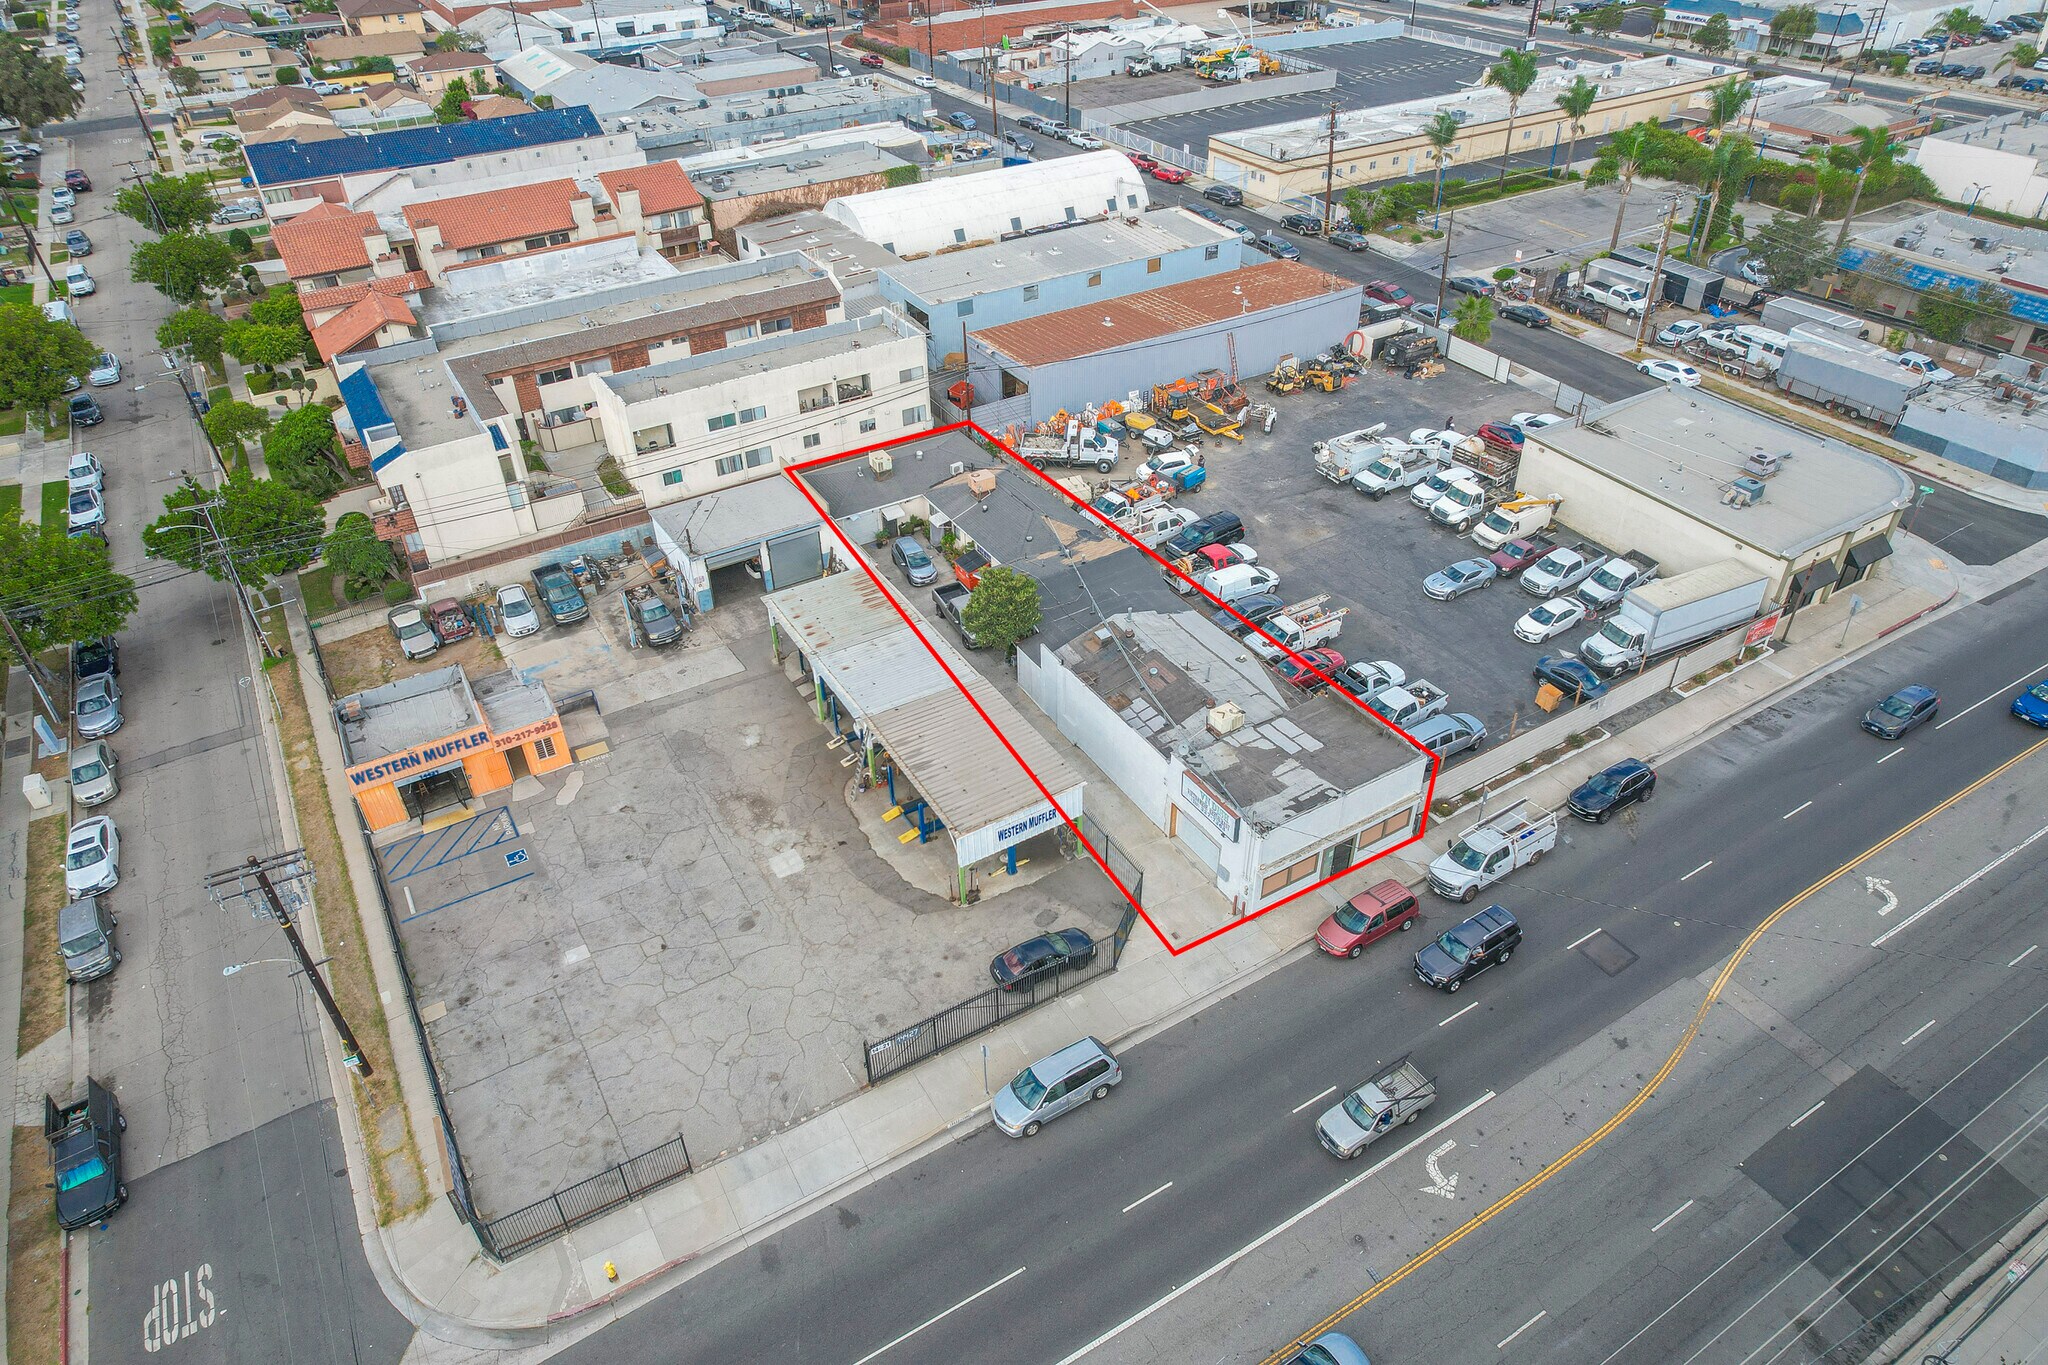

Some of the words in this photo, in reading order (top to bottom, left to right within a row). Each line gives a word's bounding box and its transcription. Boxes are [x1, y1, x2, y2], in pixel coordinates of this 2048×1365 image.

[495, 721, 559, 748] 310-217-9928
[350, 753, 421, 786] WESTERN
[423, 731, 490, 763] MUFFLER
[997, 820, 1028, 842] WESTERN
[1028, 808, 1057, 830] MUFFLER
[871, 1042, 891, 1054] 1421
[143, 1263, 216, 1353] STOP
